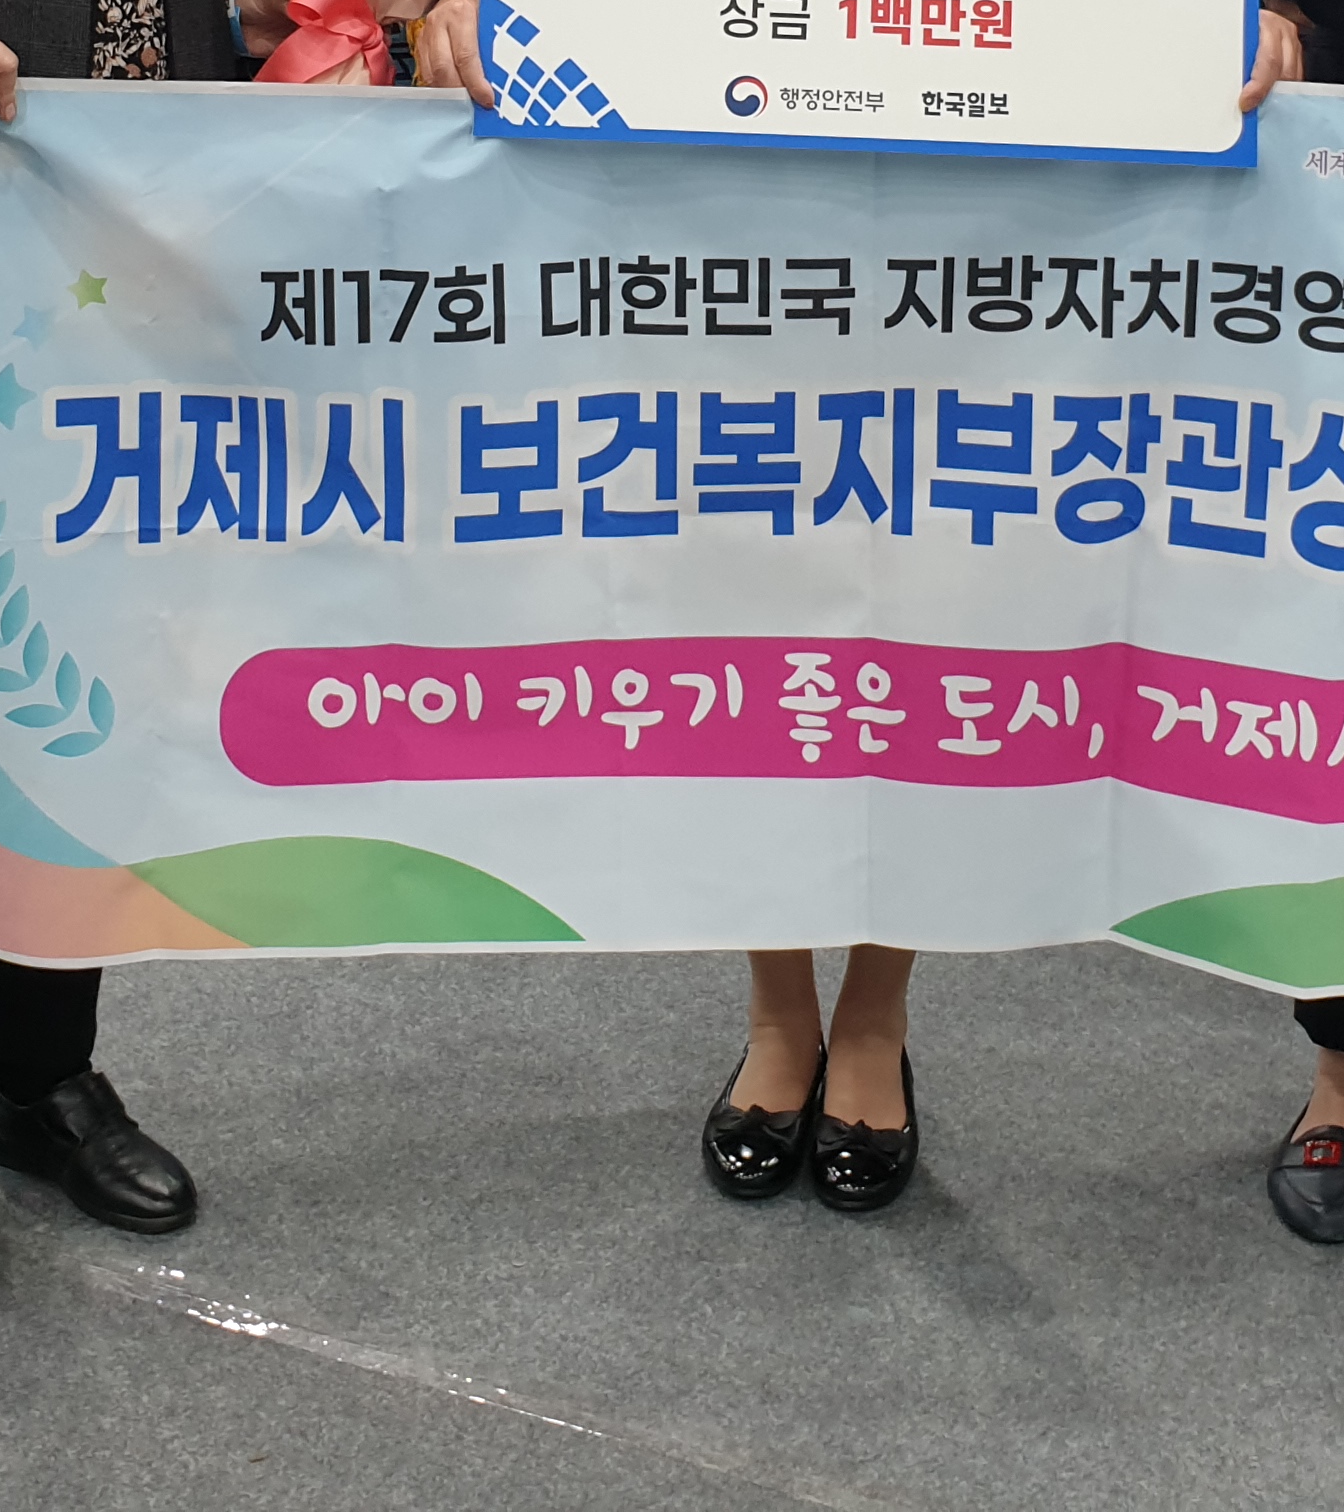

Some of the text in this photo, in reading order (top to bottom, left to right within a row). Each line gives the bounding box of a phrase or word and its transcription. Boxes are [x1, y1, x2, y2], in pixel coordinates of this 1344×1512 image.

[778, 85, 1011, 119] 행정안전부 한국일보
[259, 262, 506, 346] 제17회
[538, 255, 857, 338] 대한민국
[55, 391, 405, 545] 거제시
[307, 671, 484, 729] 아이
[516, 664, 744, 750] 키우기
[776, 652, 908, 763] 좋은
[939, 672, 1106, 760] 도시,
